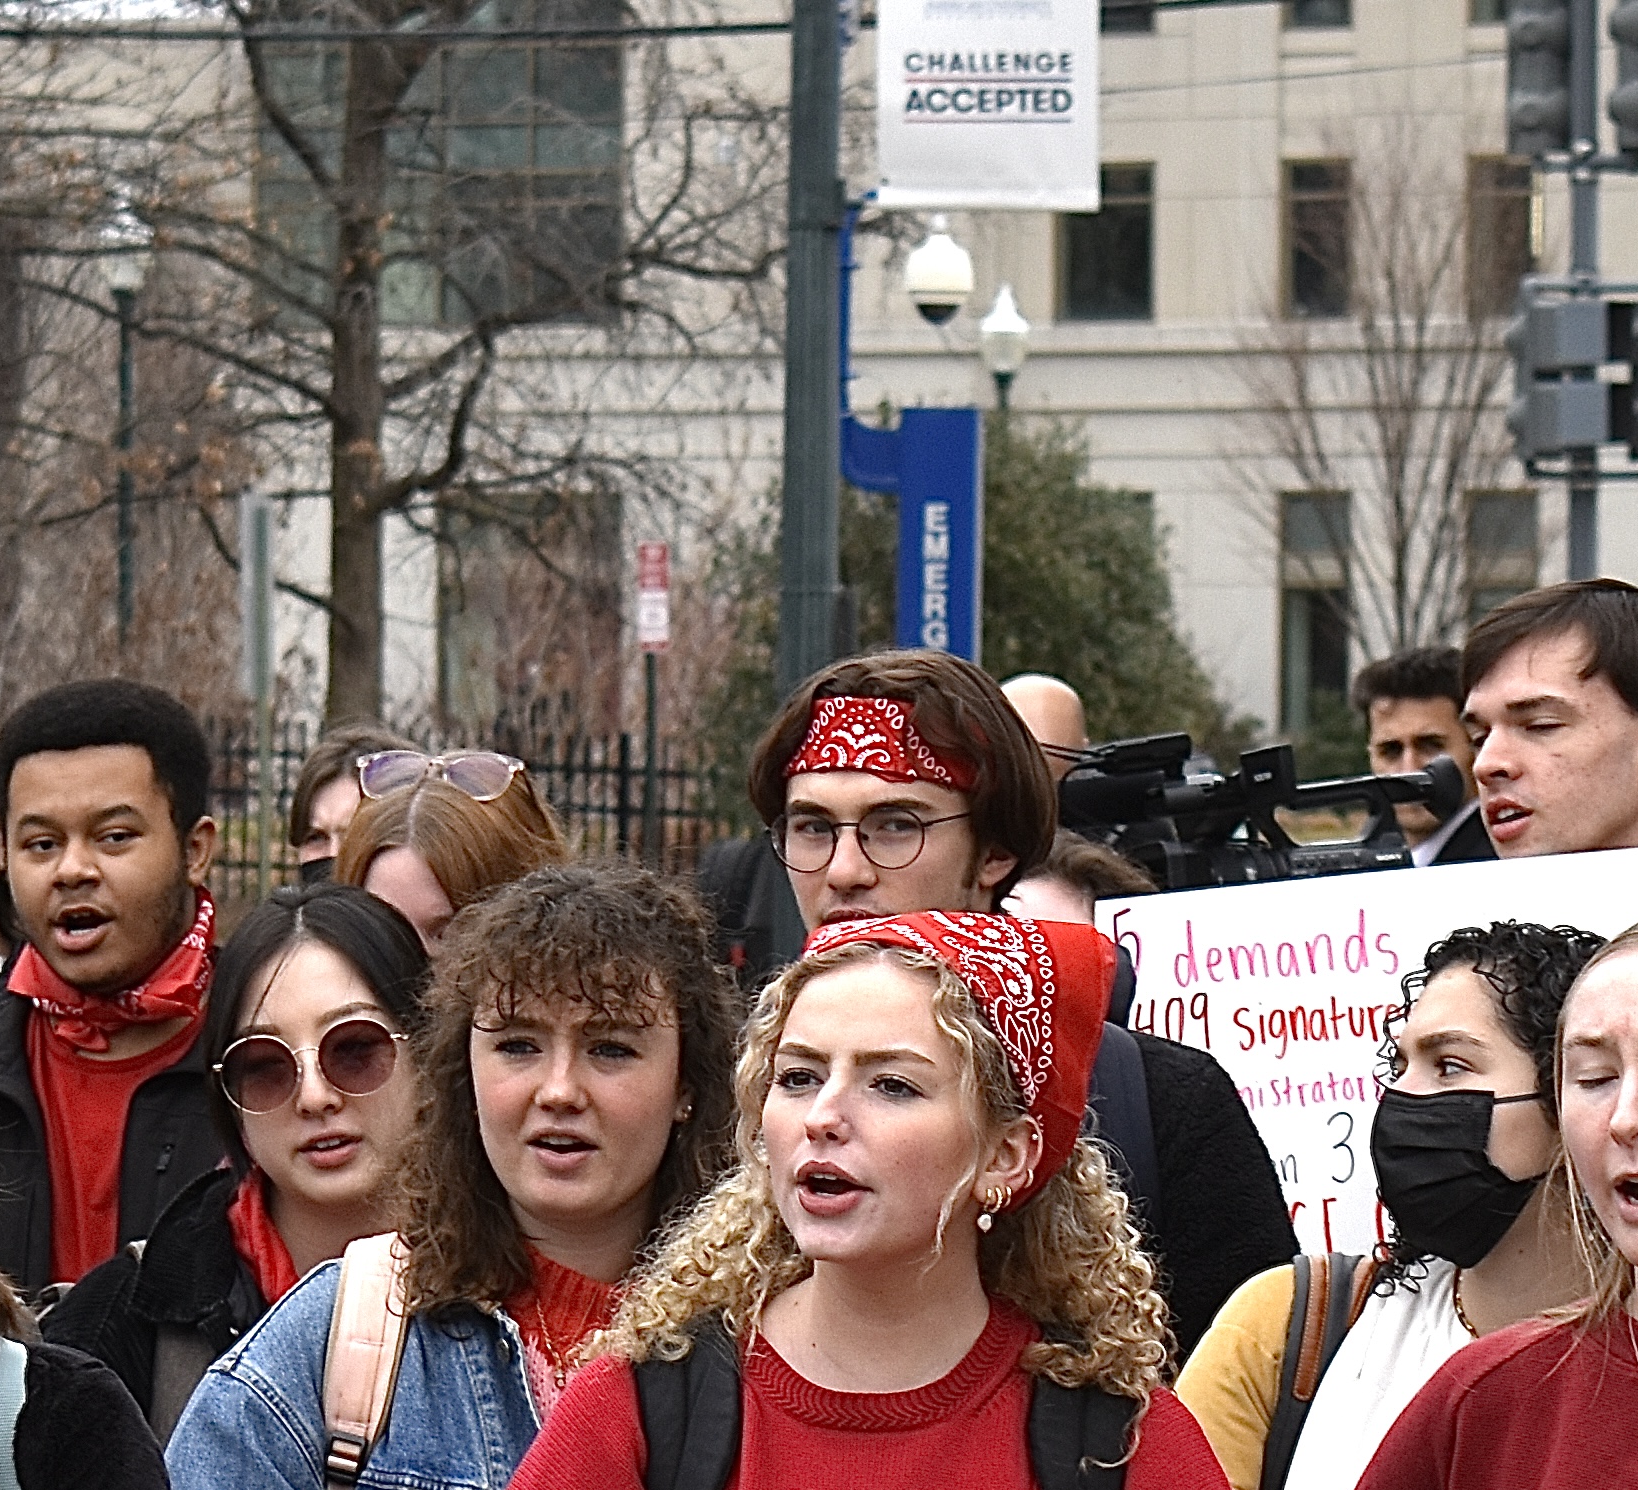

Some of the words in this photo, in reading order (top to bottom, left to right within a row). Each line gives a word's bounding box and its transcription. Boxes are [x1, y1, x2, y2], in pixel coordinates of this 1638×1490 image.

[904, 53, 1072, 74] CHALLENGE
[904, 88, 1073, 113] ACCEPTED
[921, 502, 950, 650] EMERG
[1173, 908, 1400, 988] demands
[1326, 1111, 1356, 1184] 3
